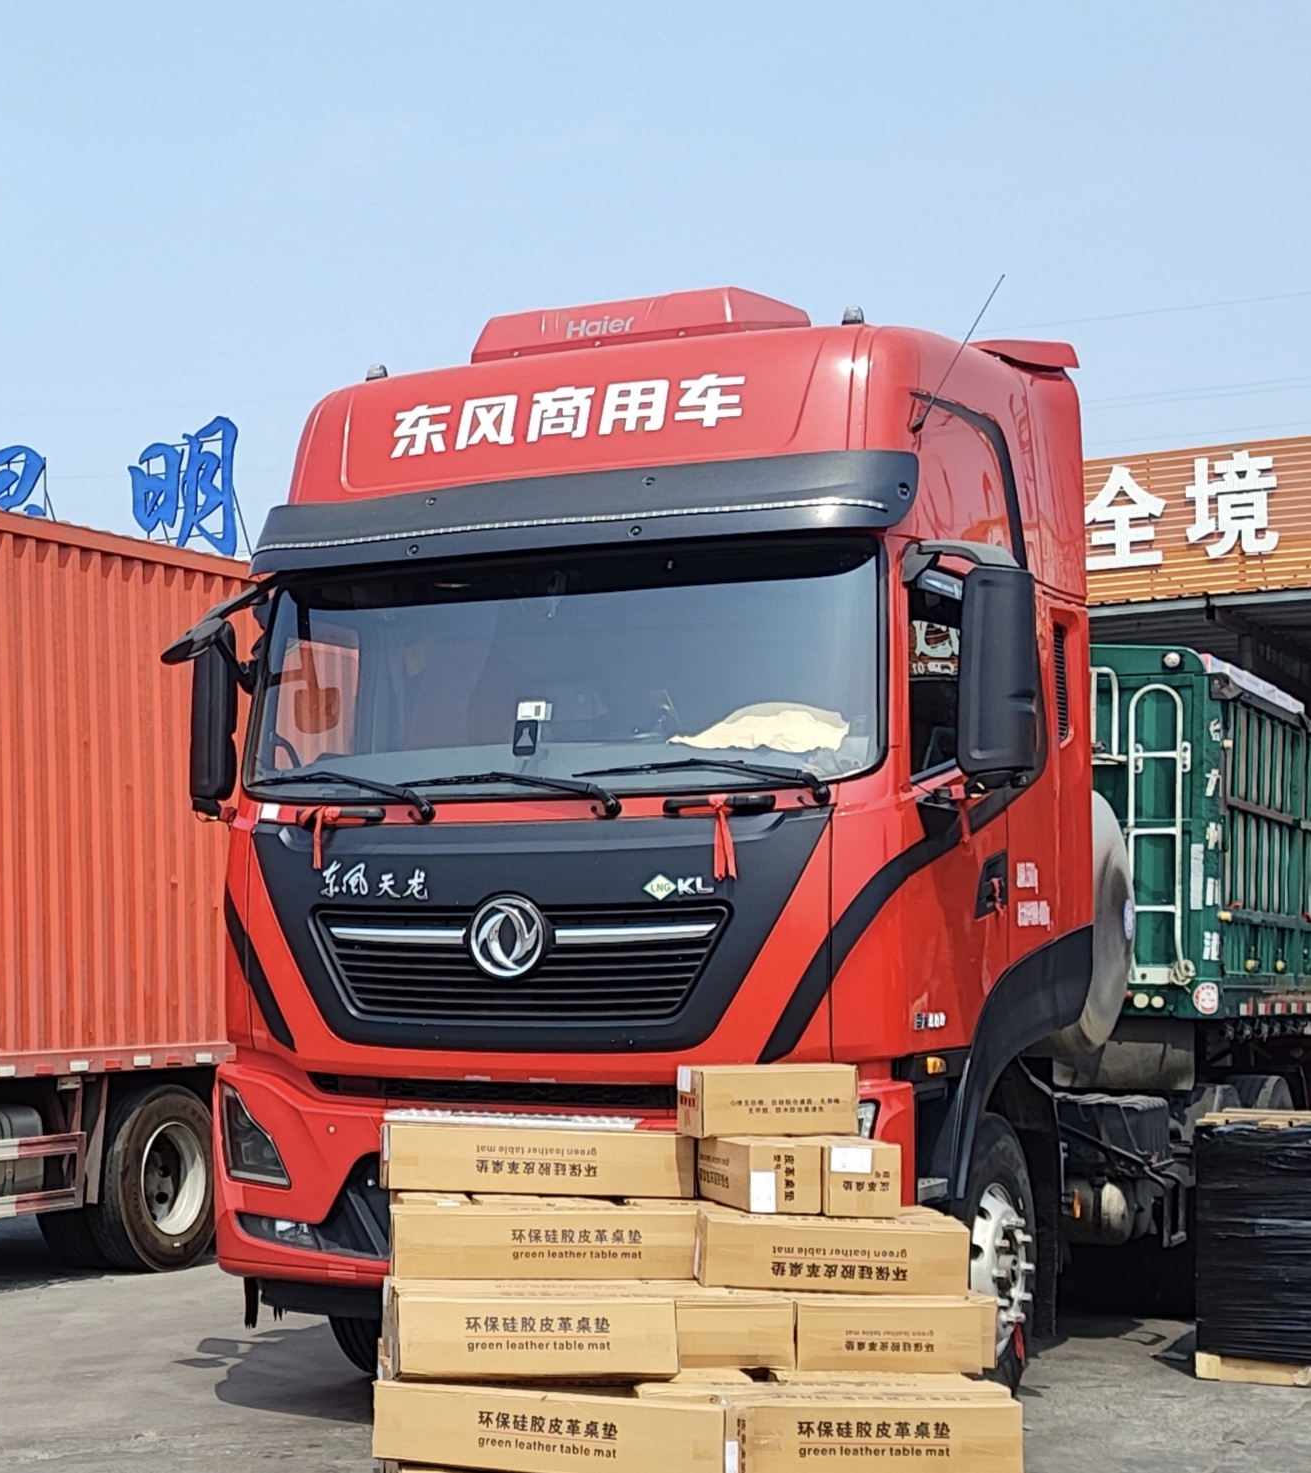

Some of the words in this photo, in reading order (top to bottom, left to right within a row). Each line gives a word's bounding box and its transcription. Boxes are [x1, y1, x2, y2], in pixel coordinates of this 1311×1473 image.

[566, 315, 635, 339] Haier
[390, 373, 745, 458] 东风商用车
[1084, 449, 1281, 571] 全境
[651, 883, 671, 892] LNG
[677, 876, 715, 896] KL
[476, 1144, 496, 1152] mat
[498, 1145, 525, 1155] table
[527, 1147, 565, 1157] leather
[567, 1147, 597, 1157] green
[476, 1159, 598, 1177] 环保硅胶皮革桌垫
[511, 1228, 642, 1244] 环保硅胶皮革桌垫
[512, 1251, 545, 1260] green
[547, 1250, 587, 1259] leather
[590, 1250, 619, 1259] table
[621, 1250, 642, 1259] mat
[772, 1245, 795, 1254] mat
[797, 1246, 826, 1256] table
[829, 1248, 871, 1258] leather
[874, 1249, 908, 1259] green
[771, 1261, 908, 1281] 环保硅胶皮革桌垫
[465, 1316, 610, 1333] 环保硅胶皮革桌垫
[467, 1341, 502, 1352] green
[506, 1340, 550, 1350] leather
[553, 1340, 585, 1350] table
[587, 1340, 611, 1350] mat
[478, 1411, 618, 1440] 环保硅胶皮革桌垫
[797, 1420, 951, 1439] 环保硅胶皮革桌垫
[478, 1436, 511, 1448] green
[515, 1438, 557, 1452] leather
[560, 1443, 590, 1456] table
[593, 1448, 617, 1459] mat
[799, 1447, 837, 1458] green
[840, 1445, 887, 1456] leather
[890, 1446, 922, 1457] table
[925, 1447, 951, 1457] mat
